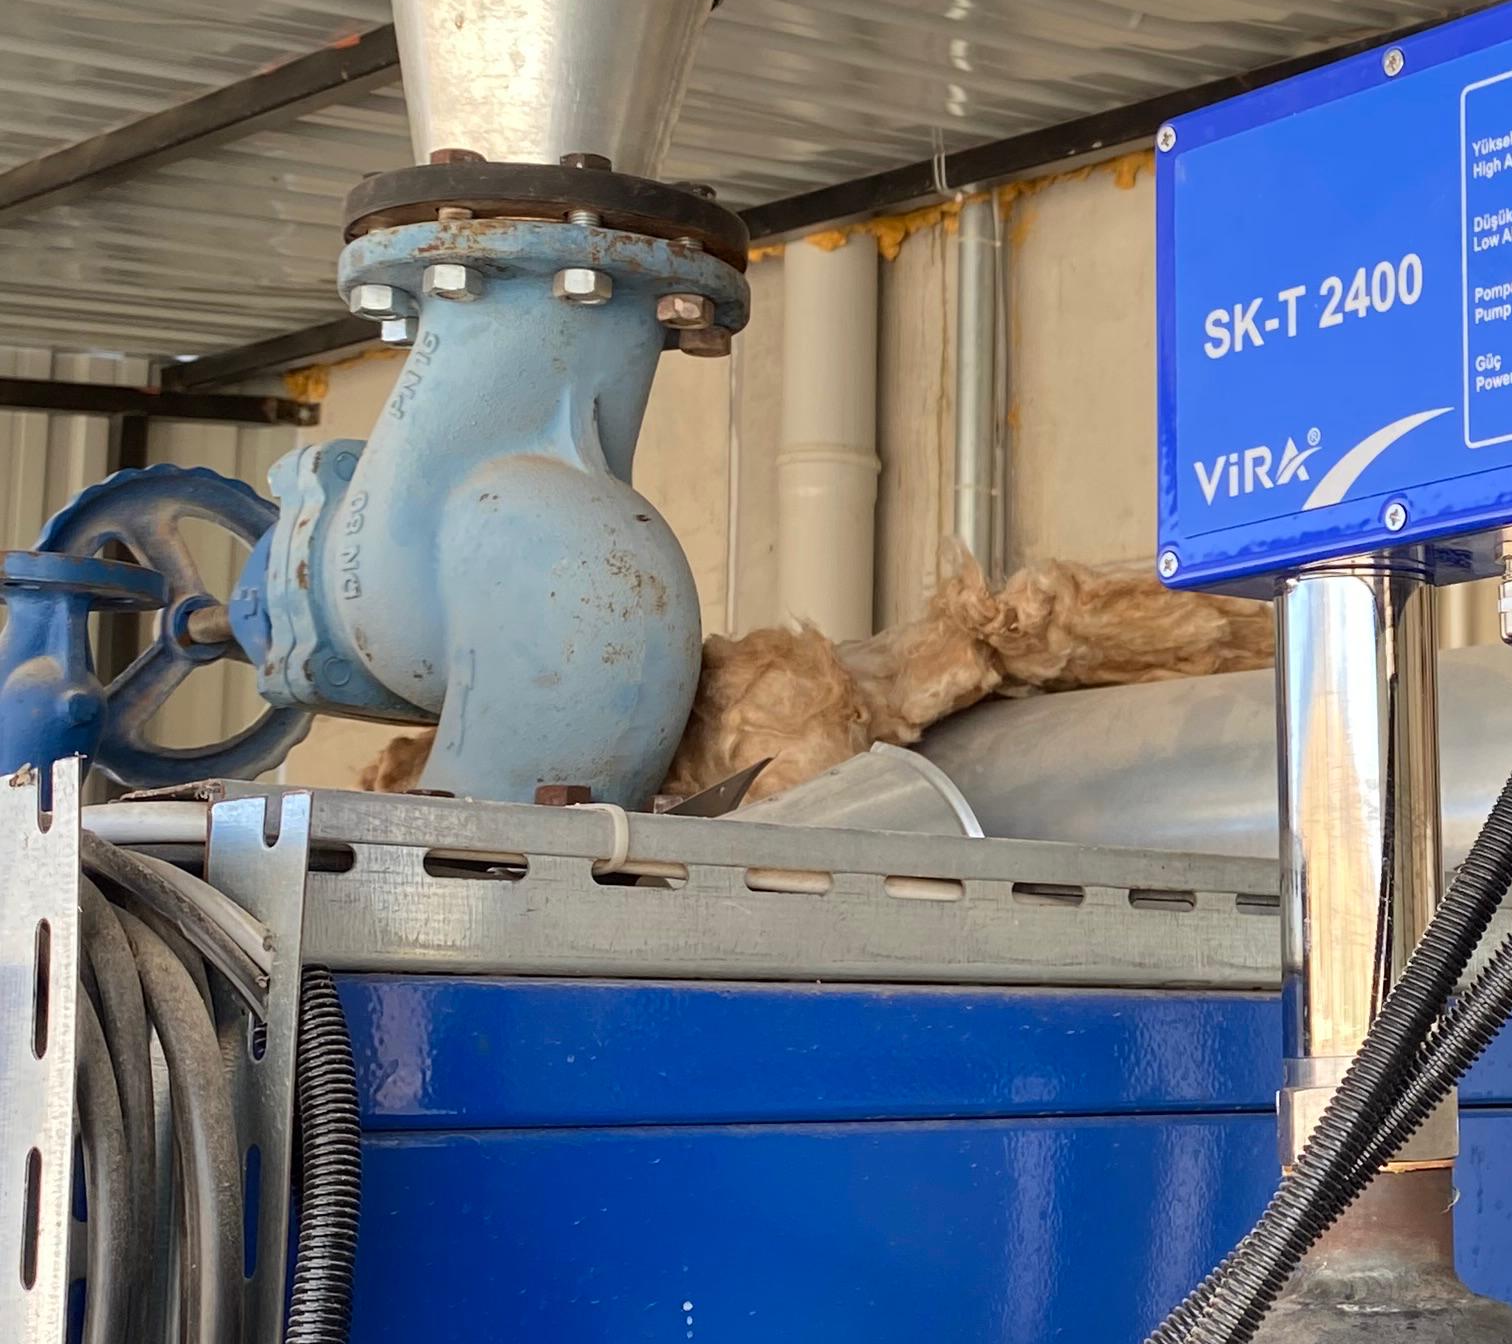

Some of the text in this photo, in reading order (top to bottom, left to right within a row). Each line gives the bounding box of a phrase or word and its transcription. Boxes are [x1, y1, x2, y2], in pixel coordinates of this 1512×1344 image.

[1472, 158, 1501, 179] High
[1473, 207, 1512, 233] Düşük
[1473, 233, 1500, 252] Low
[1203, 253, 1423, 359] SK-T 2400
[1474, 304, 1512, 325] Pump
[1475, 353, 1502, 372] Güç
